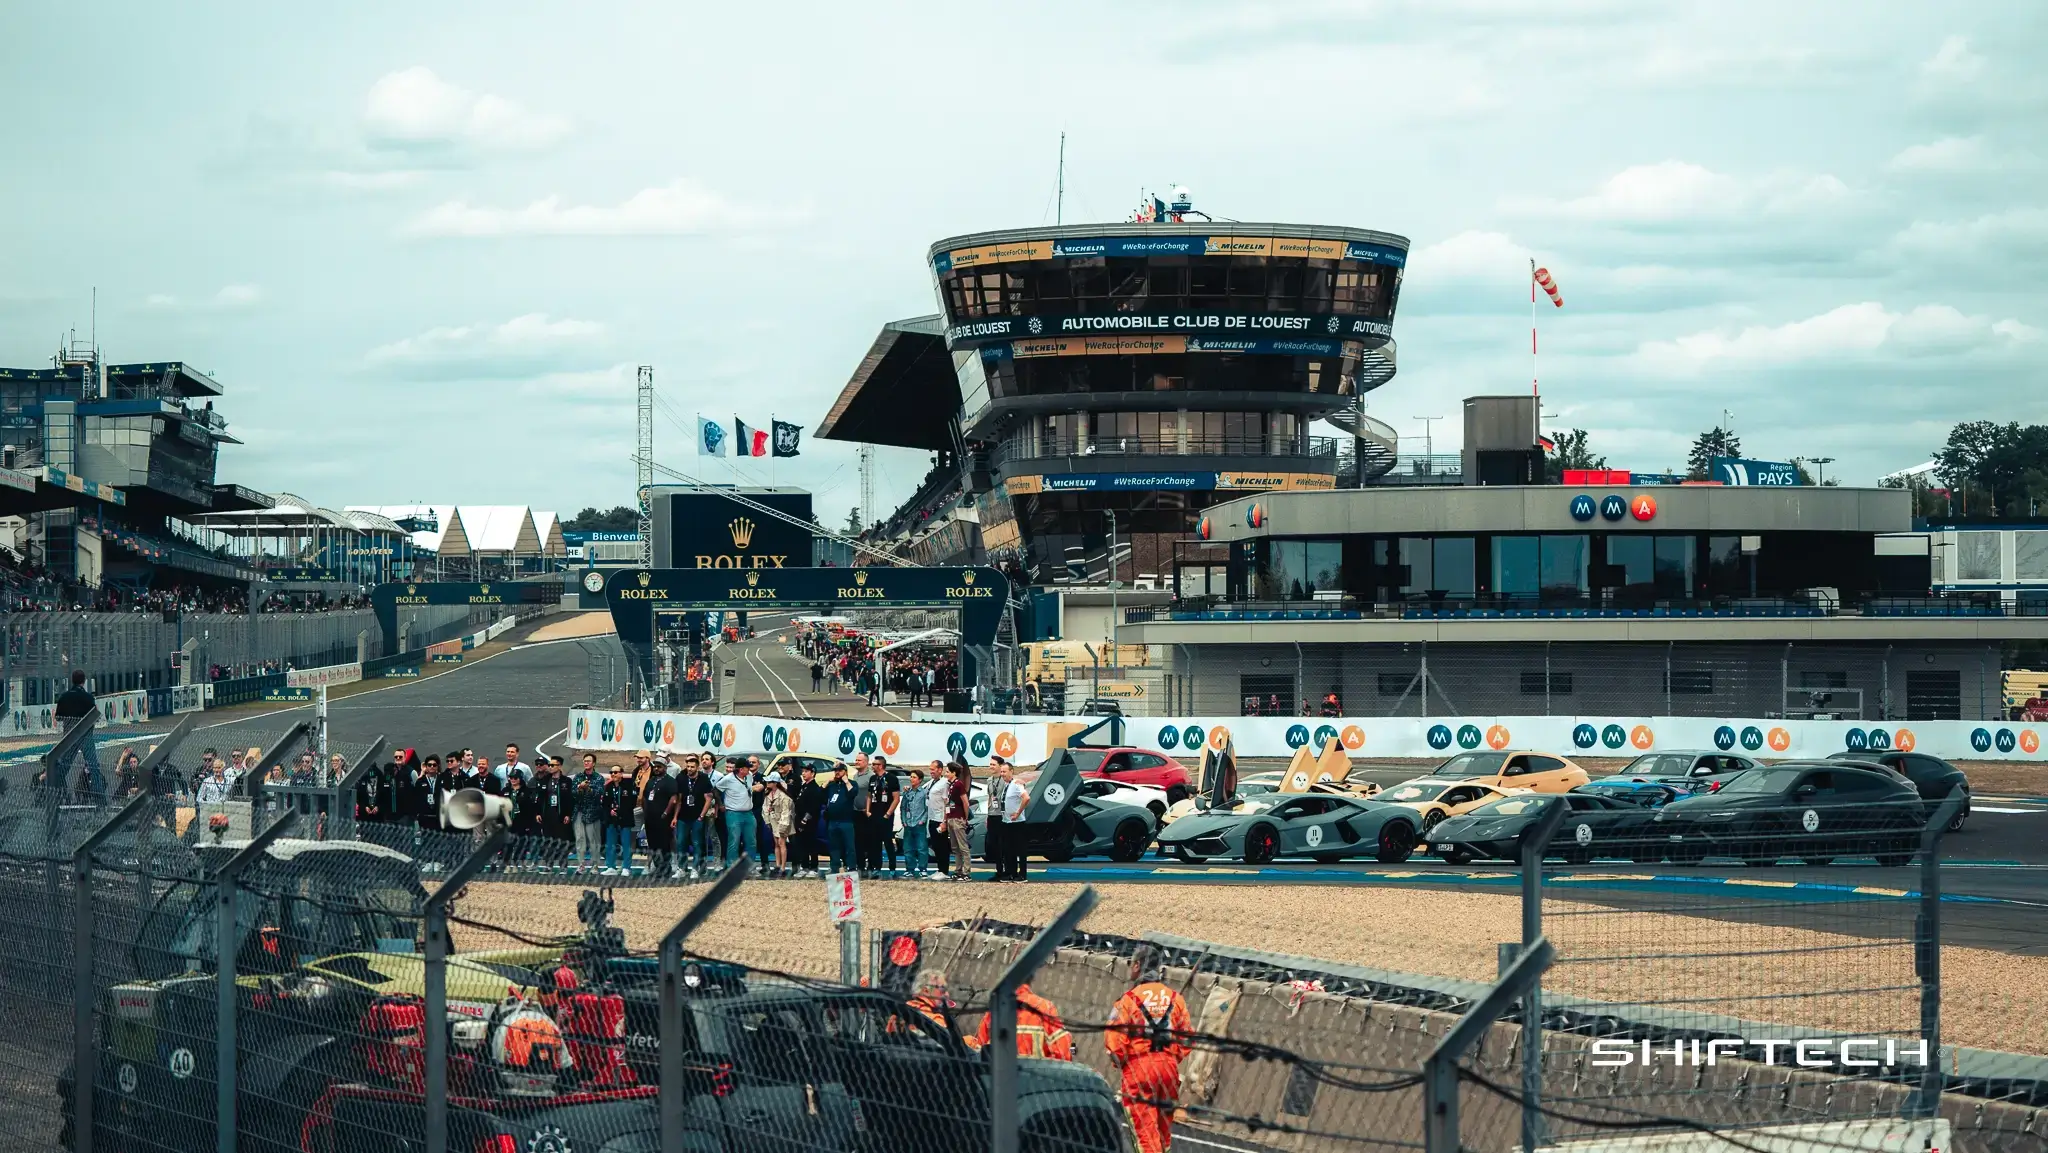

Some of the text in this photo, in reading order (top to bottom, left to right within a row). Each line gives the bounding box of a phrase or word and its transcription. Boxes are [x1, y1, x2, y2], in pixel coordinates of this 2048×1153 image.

[1065, 242, 1189, 253] MICHELIN #WeRaceForChange
[1062, 316, 1311, 330] AUTOMOBILE CLUB DE L'OUEST
[962, 325, 972, 337] DE
[973, 321, 1011, 335] L'OUEST
[1024, 341, 1164, 352] MICHELIN #WeRaceForChange
[1203, 341, 1256, 349] MICHELIN
[1770, 463, 1793, 472] Région
[1052, 477, 1195, 487] MICHELIN #WeRaceForChange
[1758, 472, 1793, 485] PAYS
[620, 589, 668, 599] ROLEX
[729, 588, 776, 598] ROLEX
[837, 588, 885, 598] ROLEX
[945, 587, 993, 597] ROLEX
[395, 596, 428, 604] ROLEX
[469, 595, 501, 603] ROLEX
[173, 1052, 190, 1072] 40
